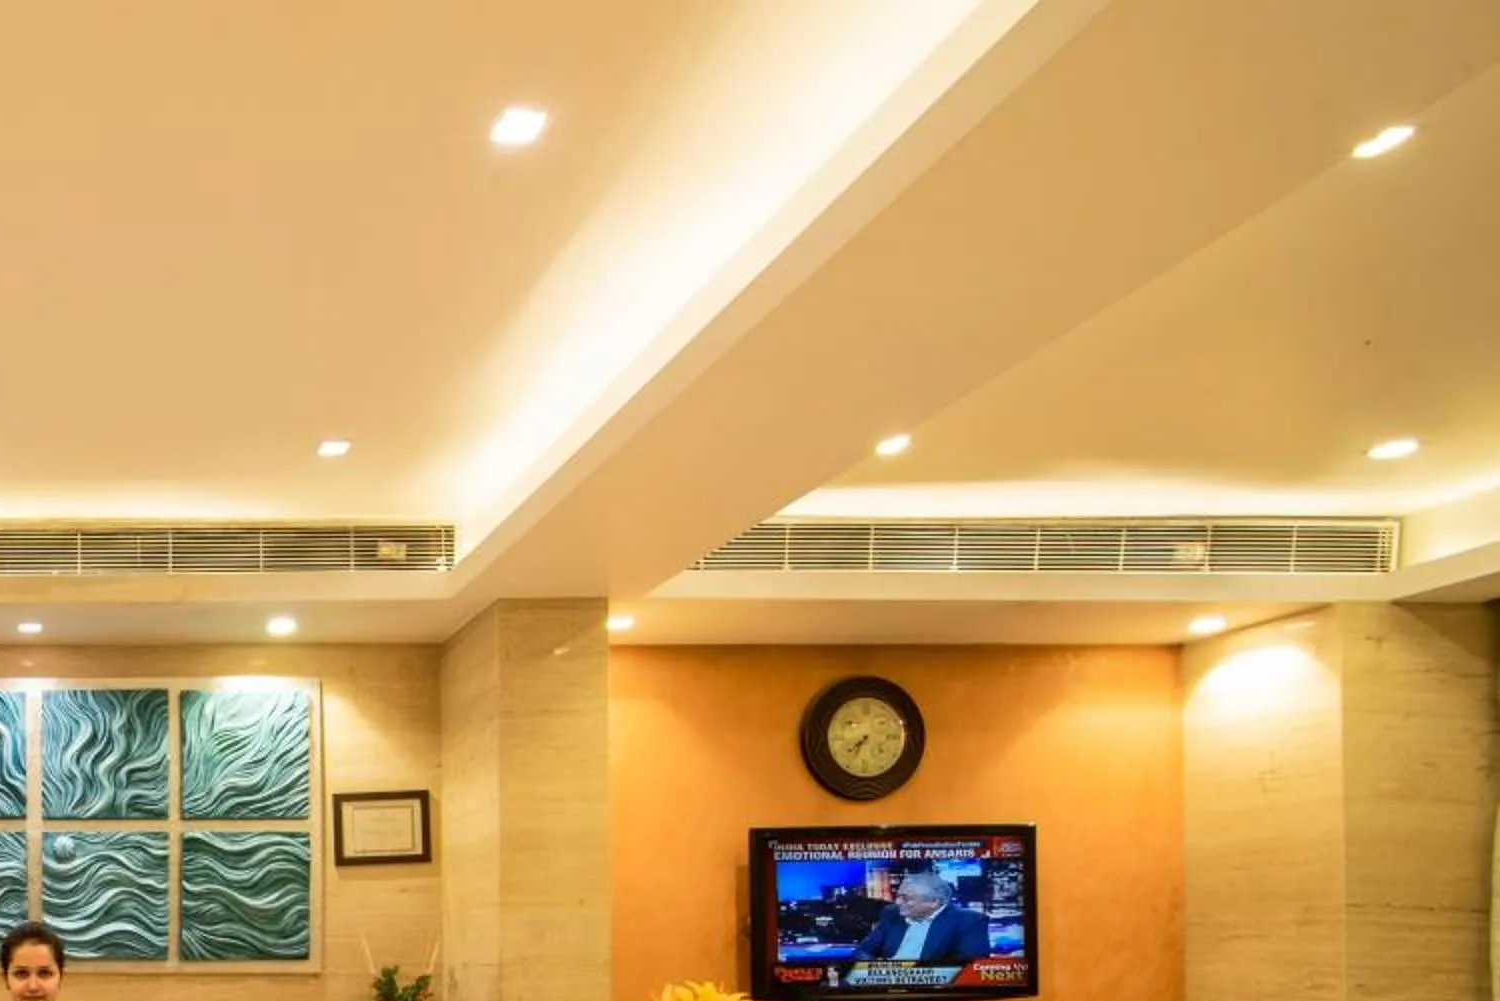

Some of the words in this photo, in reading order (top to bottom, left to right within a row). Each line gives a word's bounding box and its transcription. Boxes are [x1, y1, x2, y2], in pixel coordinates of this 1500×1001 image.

[774, 851, 843, 860] EMOTIONAL
[900, 849, 920, 859] FOR
[980, 971, 1024, 981] Next
